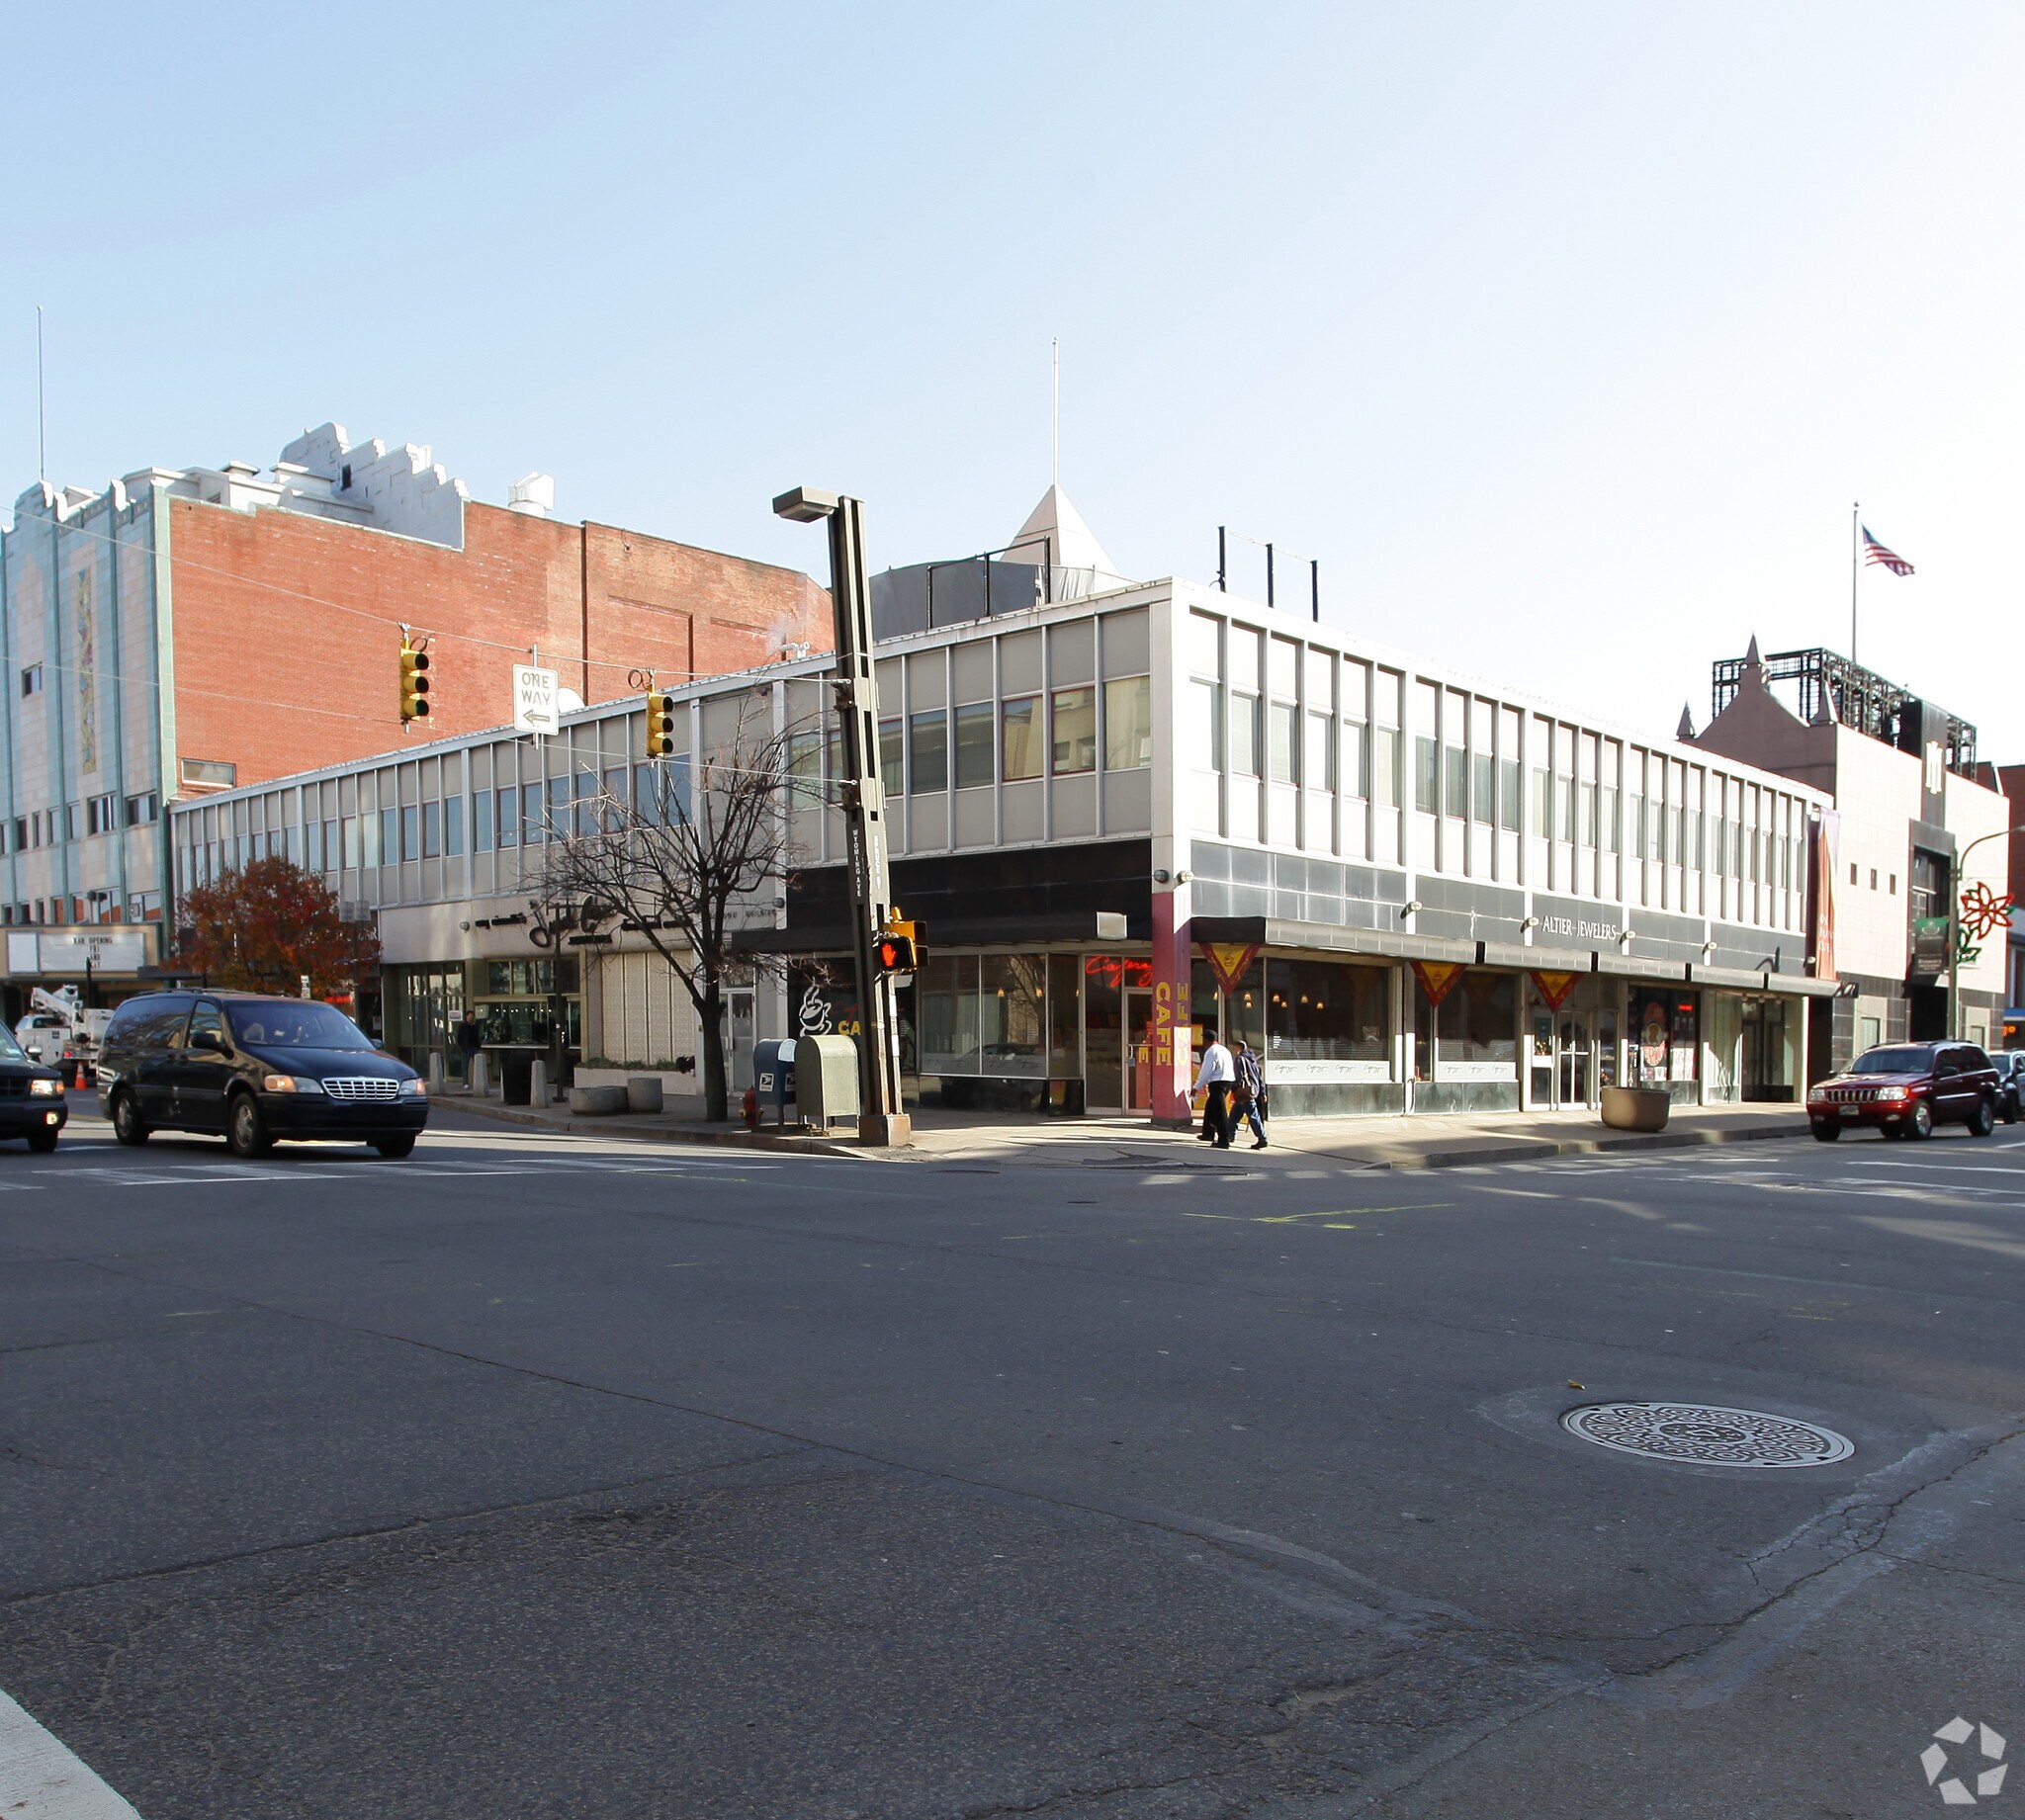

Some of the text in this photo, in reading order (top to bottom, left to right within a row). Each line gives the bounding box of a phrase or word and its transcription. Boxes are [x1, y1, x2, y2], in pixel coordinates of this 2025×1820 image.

[521, 672, 550, 688] ONE
[521, 689, 551, 706] WAY
[852, 828, 861, 875] WYOMING
[73, 936, 113, 945] BAR OPENING
[1541, 915, 1617, 941] ALTIER JEWELERS
[1156, 981, 1172, 1067] CAFE
[1175, 982, 1189, 1067] CAFE
